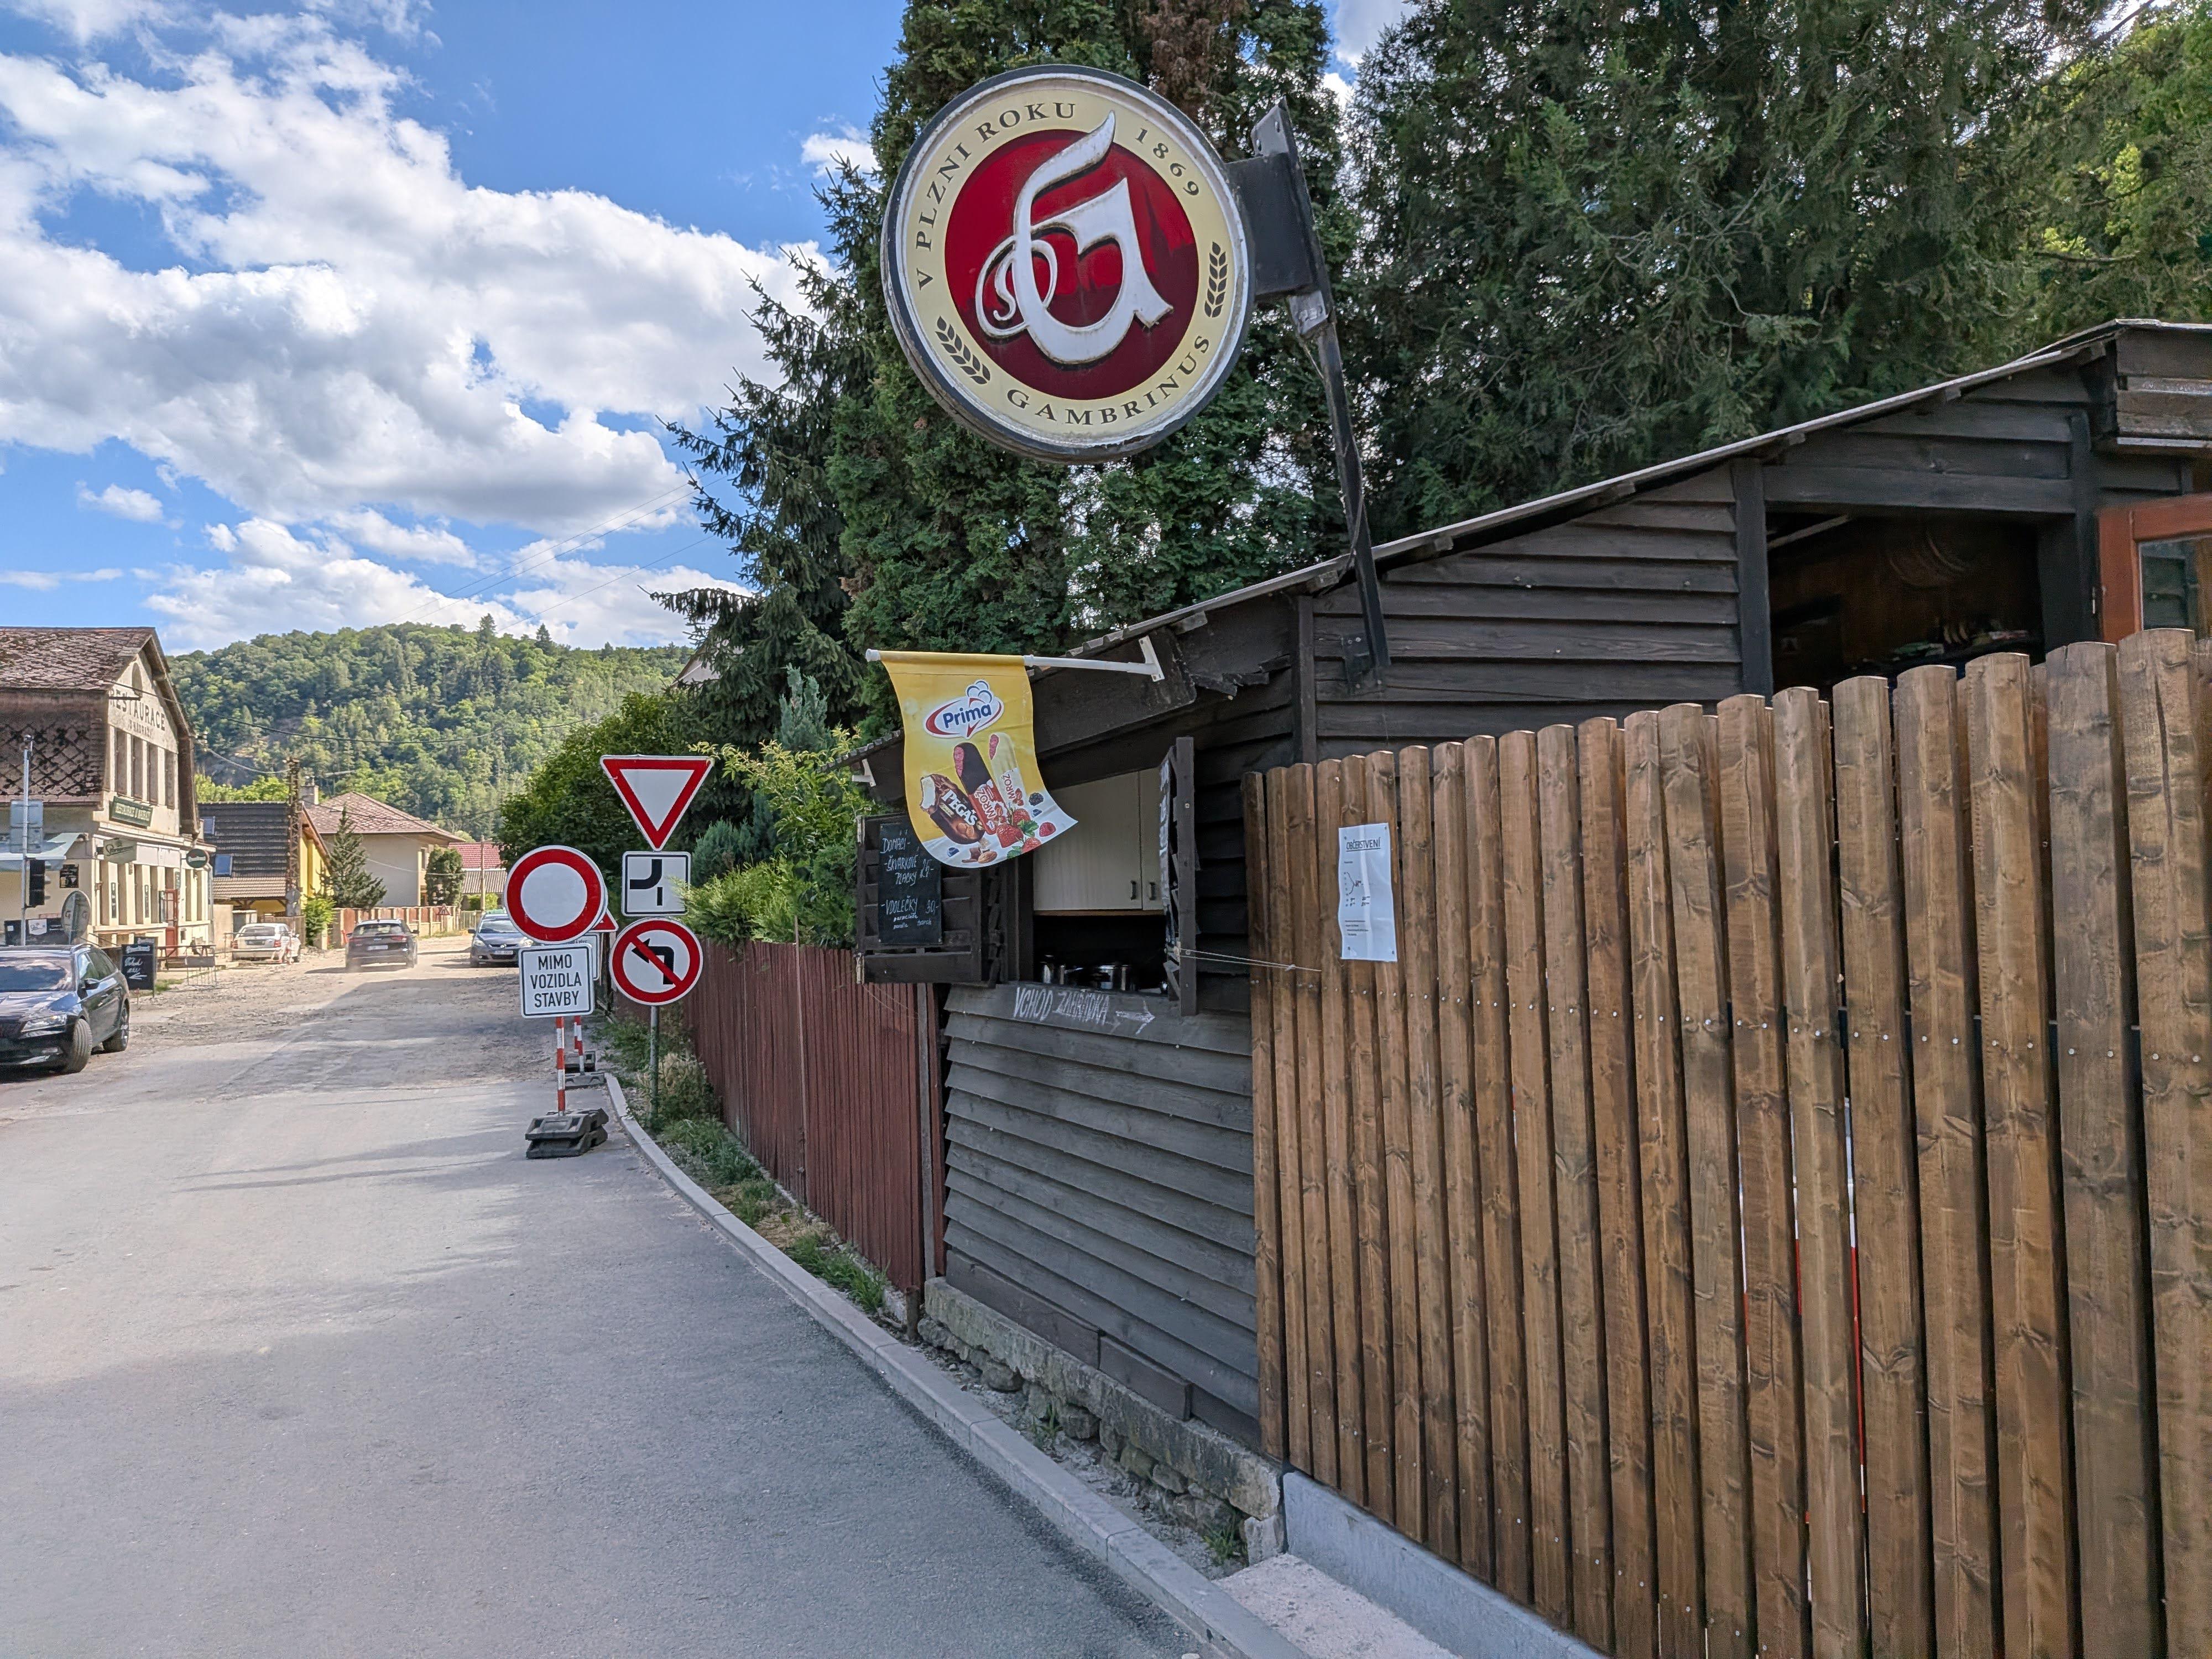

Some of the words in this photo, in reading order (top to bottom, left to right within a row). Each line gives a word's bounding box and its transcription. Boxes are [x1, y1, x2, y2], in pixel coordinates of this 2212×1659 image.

[975, 102, 1076, 143] ROKU
[1135, 128, 1200, 196] 1869
[916, 142, 972, 252] PLZNI
[916, 269, 934, 290] V
[1006, 335, 1211, 426] GAMBRINUS
[108, 689, 165, 731] RESTAURACE
[942, 704, 992, 729] Prima
[1000, 773, 1016, 800] MROŽ
[975, 787, 997, 819] MROŽ
[538, 953, 572, 970] MIMO
[530, 972, 582, 990] VOZIDLA
[534, 990, 580, 1009] STAVBY
[1014, 986, 1053, 1022] VCHOD
